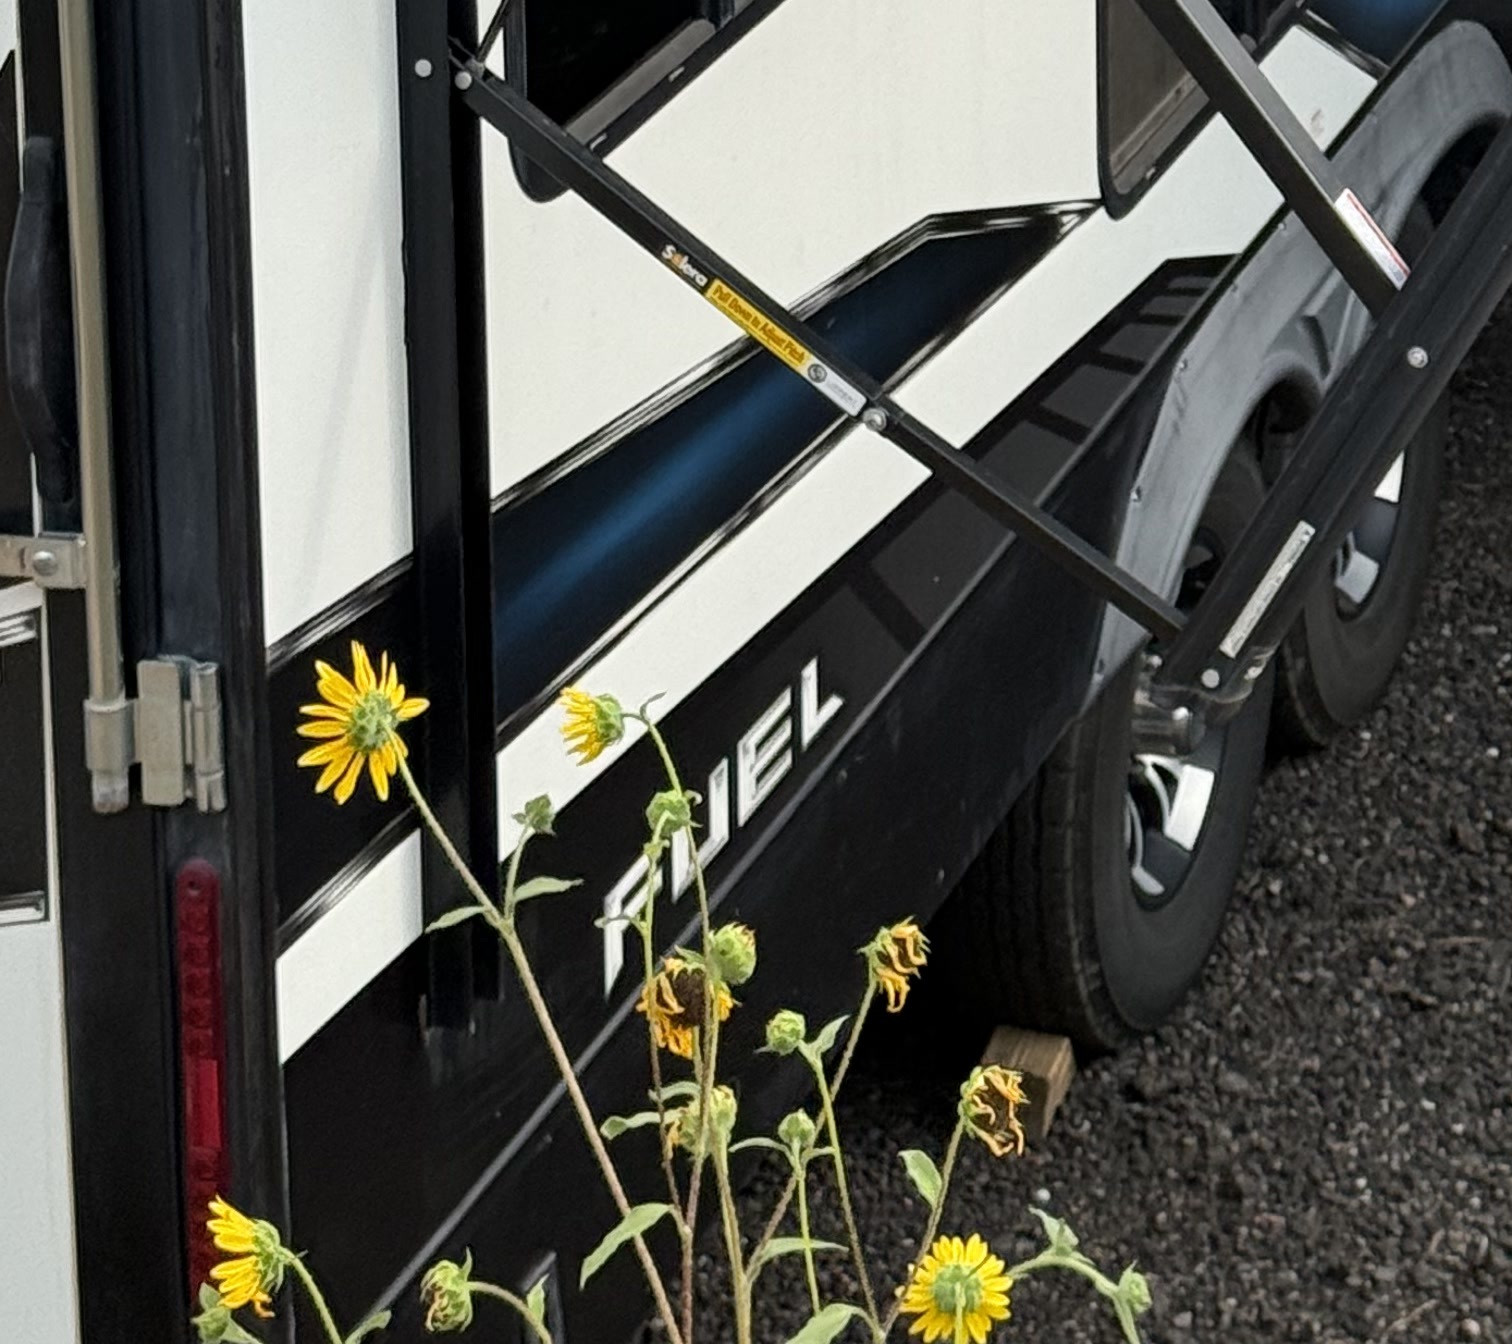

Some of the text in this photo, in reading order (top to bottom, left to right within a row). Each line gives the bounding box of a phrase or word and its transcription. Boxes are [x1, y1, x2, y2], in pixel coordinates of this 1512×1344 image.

[661, 244, 708, 287] Solera
[712, 285, 732, 303] Pull
[728, 297, 753, 322] Down
[602, 656, 846, 1002] FUEL
